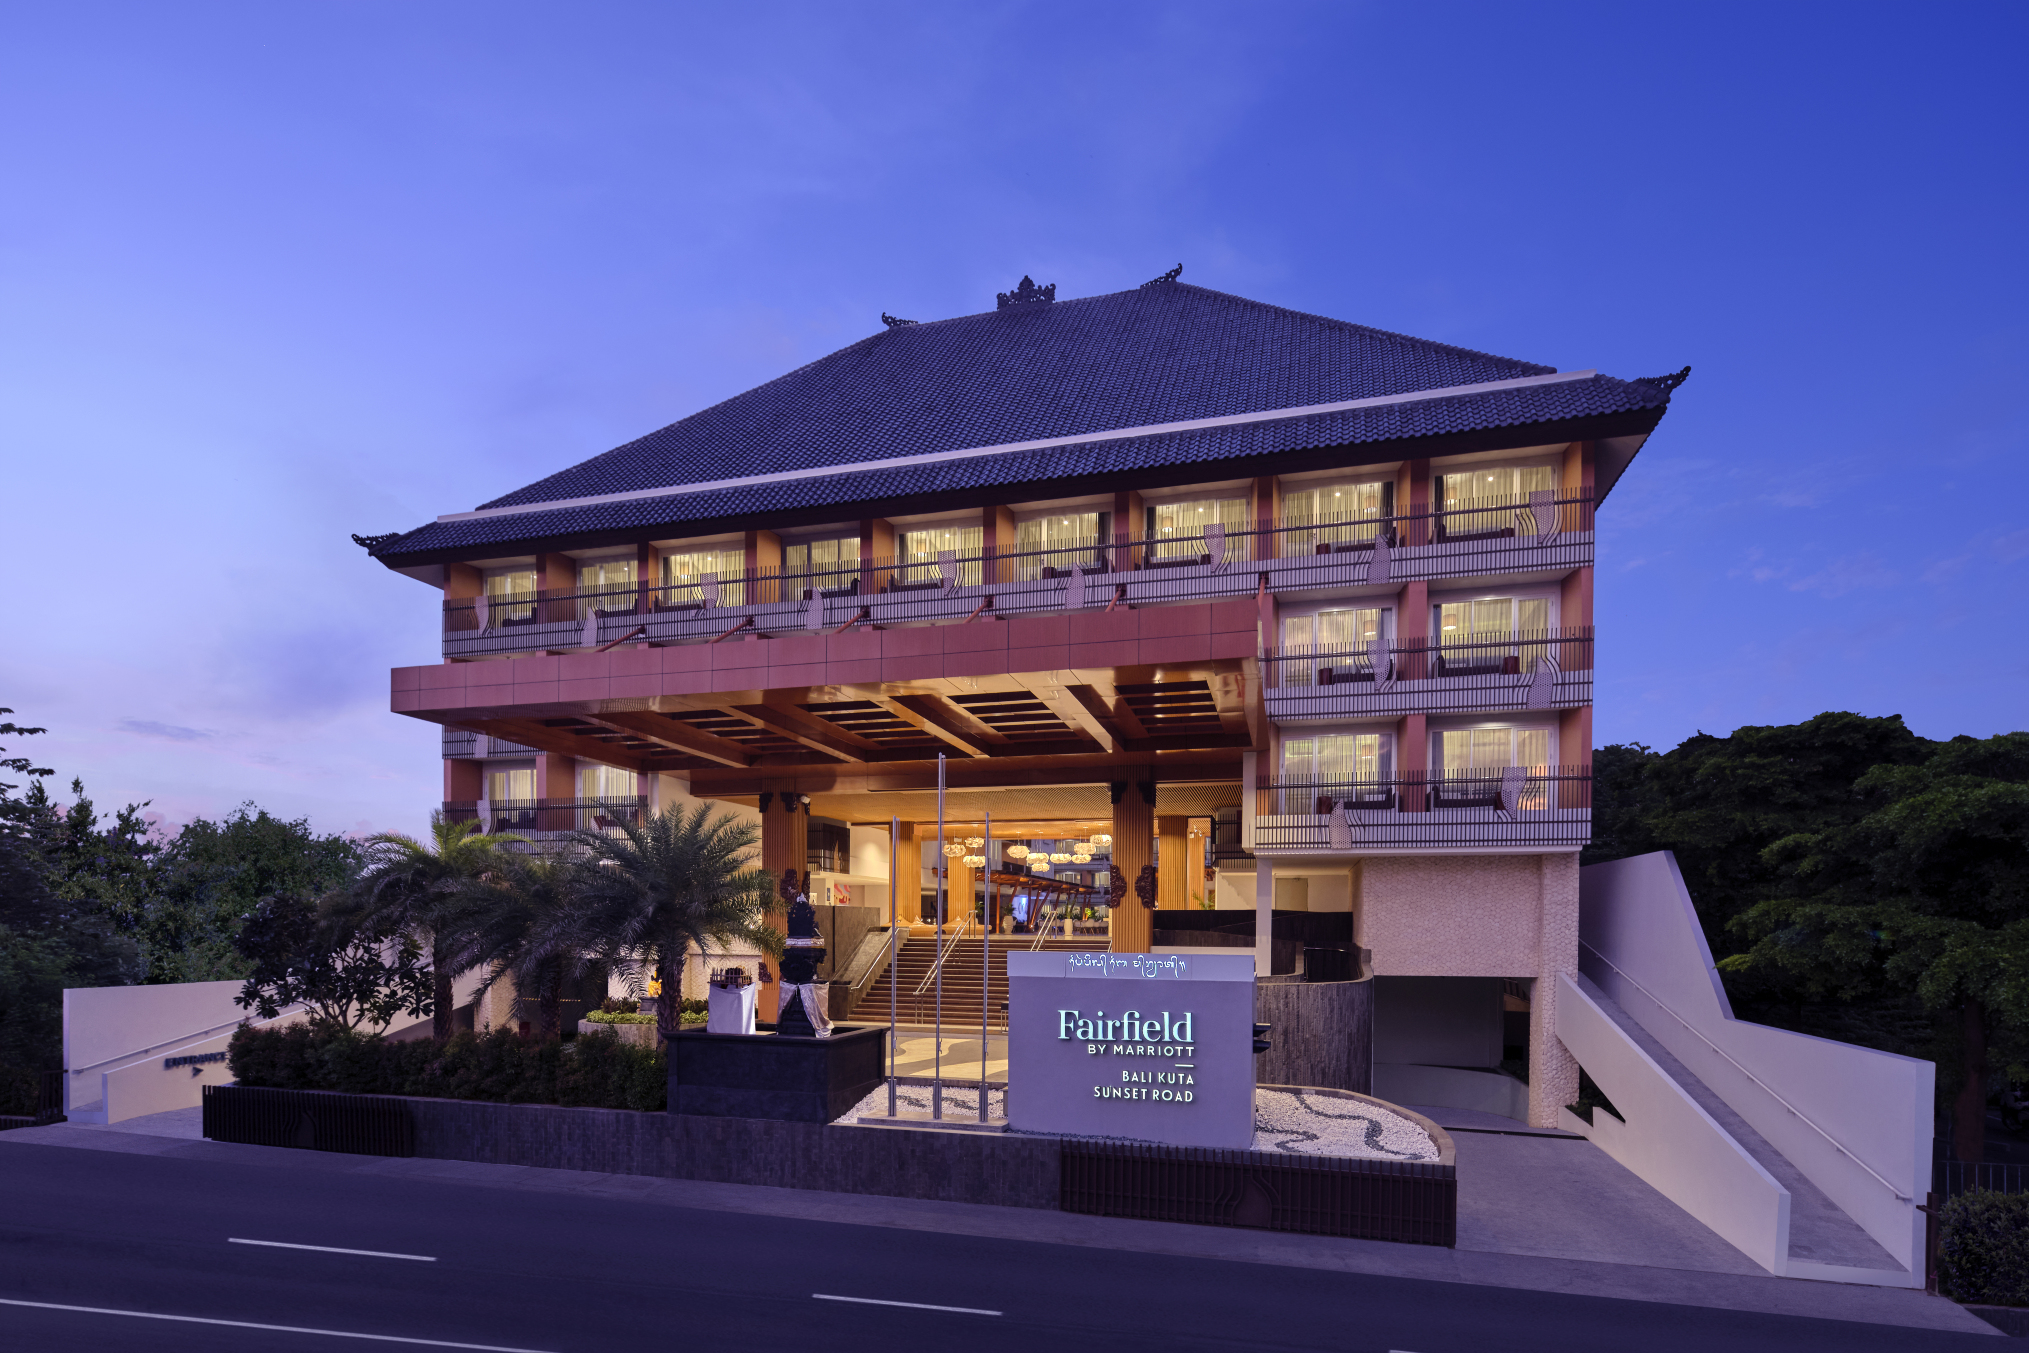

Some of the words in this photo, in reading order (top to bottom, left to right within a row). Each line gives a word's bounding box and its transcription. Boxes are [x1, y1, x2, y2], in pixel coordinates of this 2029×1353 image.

[1058, 1009, 1194, 1043] Fairfield
[1088, 1044, 1107, 1055] BY
[1113, 1044, 1195, 1057] MARRIOTT
[1122, 1070, 1152, 1083] BALI
[1158, 1071, 1194, 1085] KUTA
[1094, 1085, 1148, 1100] SUNSET
[1153, 1089, 1193, 1103] ROAD
